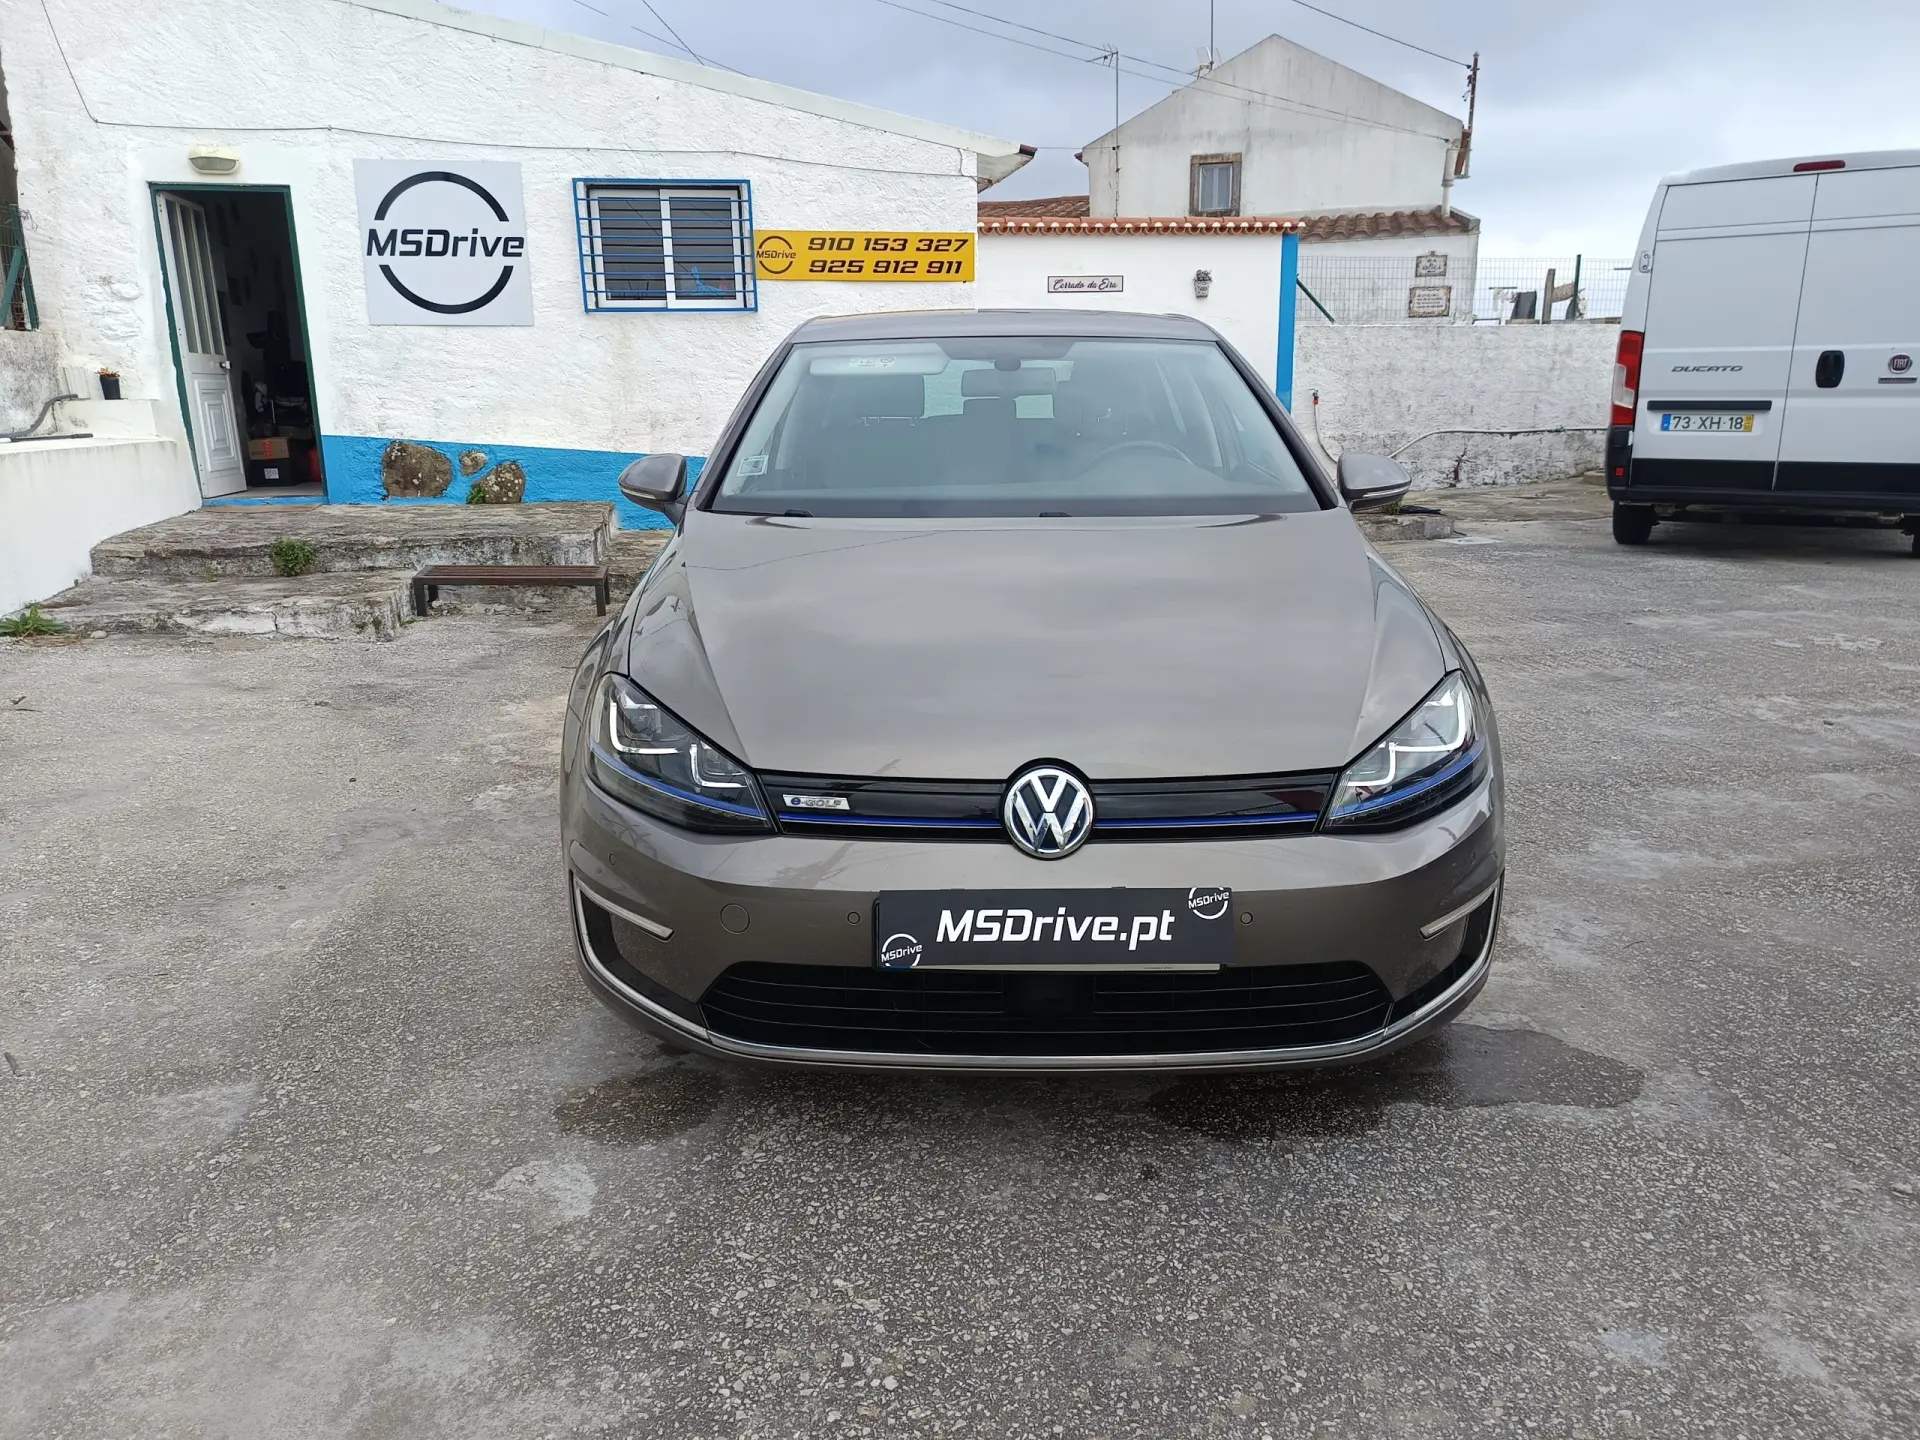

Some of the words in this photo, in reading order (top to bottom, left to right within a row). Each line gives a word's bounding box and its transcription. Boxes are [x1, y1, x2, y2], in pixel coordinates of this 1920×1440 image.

[366, 228, 525, 258] MSDrive
[808, 237, 855, 251] 910
[863, 238, 908, 252] 153
[915, 238, 969, 252] 327
[756, 250, 797, 259] MSDrive
[808, 259, 865, 273] 925
[872, 260, 919, 274] 912
[925, 260, 963, 274] 911
[1087, 281, 1098, 289] da
[1098, 278, 1118, 291] Eira
[1671, 365, 1743, 373] DUCATO
[1893, 358, 1908, 369] FIAT
[1188, 892, 1230, 909] MSDrive
[935, 907, 1176, 951] MSDrive.pt
[881, 943, 923, 963] MSDrive
